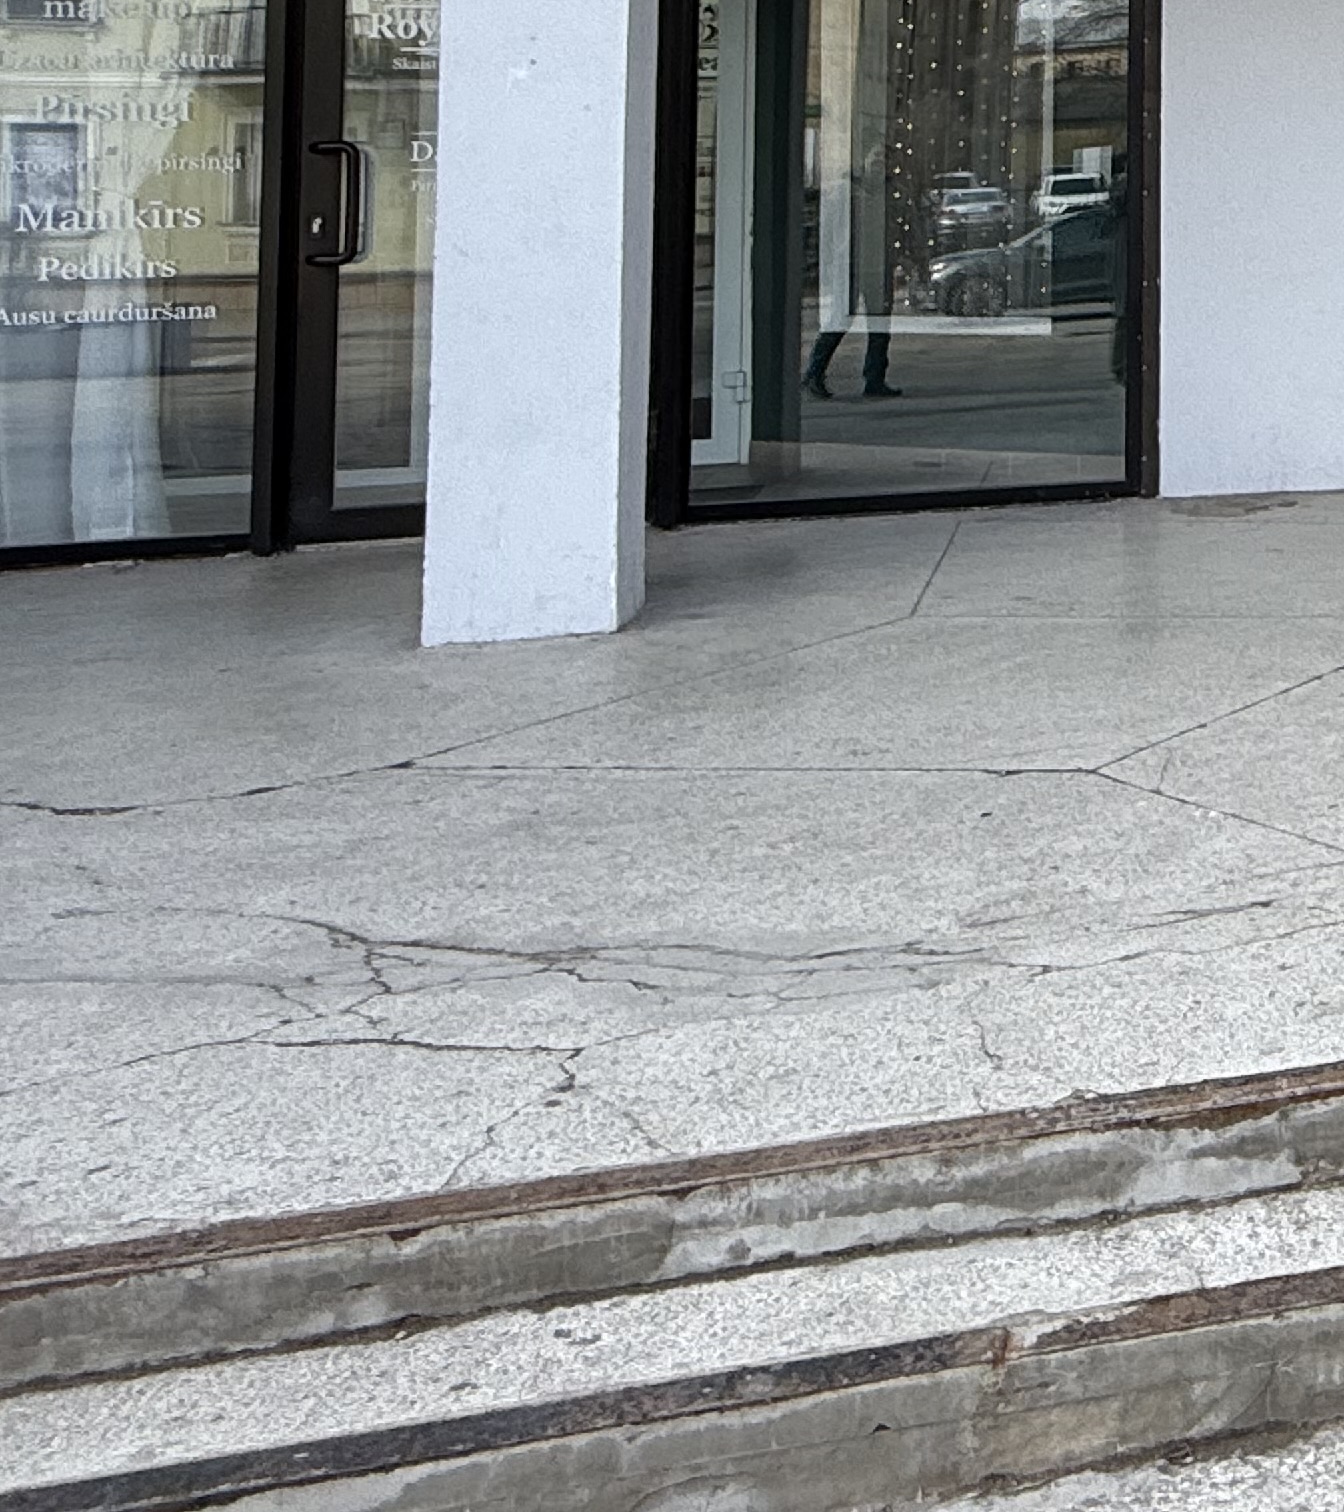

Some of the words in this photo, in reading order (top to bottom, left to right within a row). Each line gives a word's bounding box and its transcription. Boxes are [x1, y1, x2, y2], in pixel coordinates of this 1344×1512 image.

[15, 200, 203, 232] Manikīrs
[0, 306, 57, 326] Ausu
[64, 300, 217, 324] caurduršana
